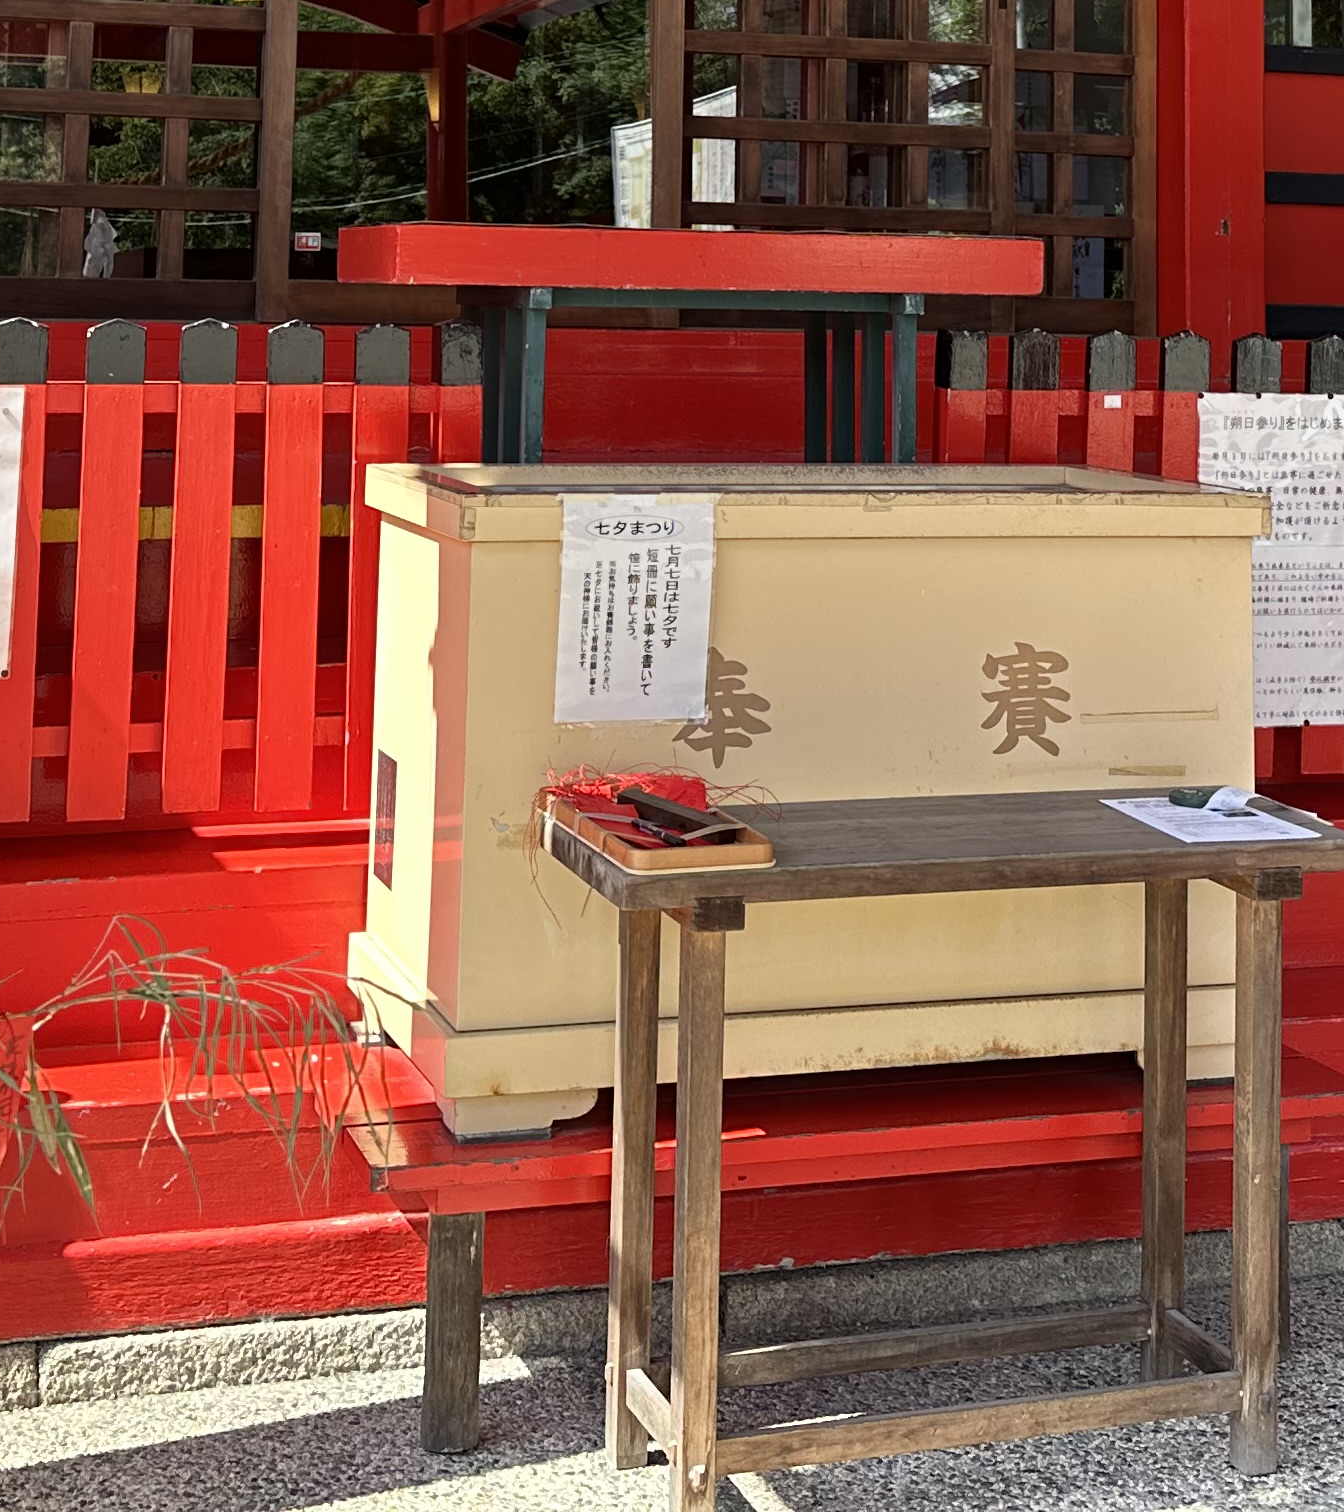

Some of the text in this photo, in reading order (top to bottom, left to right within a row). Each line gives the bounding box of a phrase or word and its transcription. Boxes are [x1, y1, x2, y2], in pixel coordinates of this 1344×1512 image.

[593, 519, 677, 536] 七夕まつり
[625, 552, 642, 641] 笹に飾りましょう。
[639, 547, 660, 697] 短冊に願い事を書いて
[660, 544, 682, 649] 七月七日は七夕です
